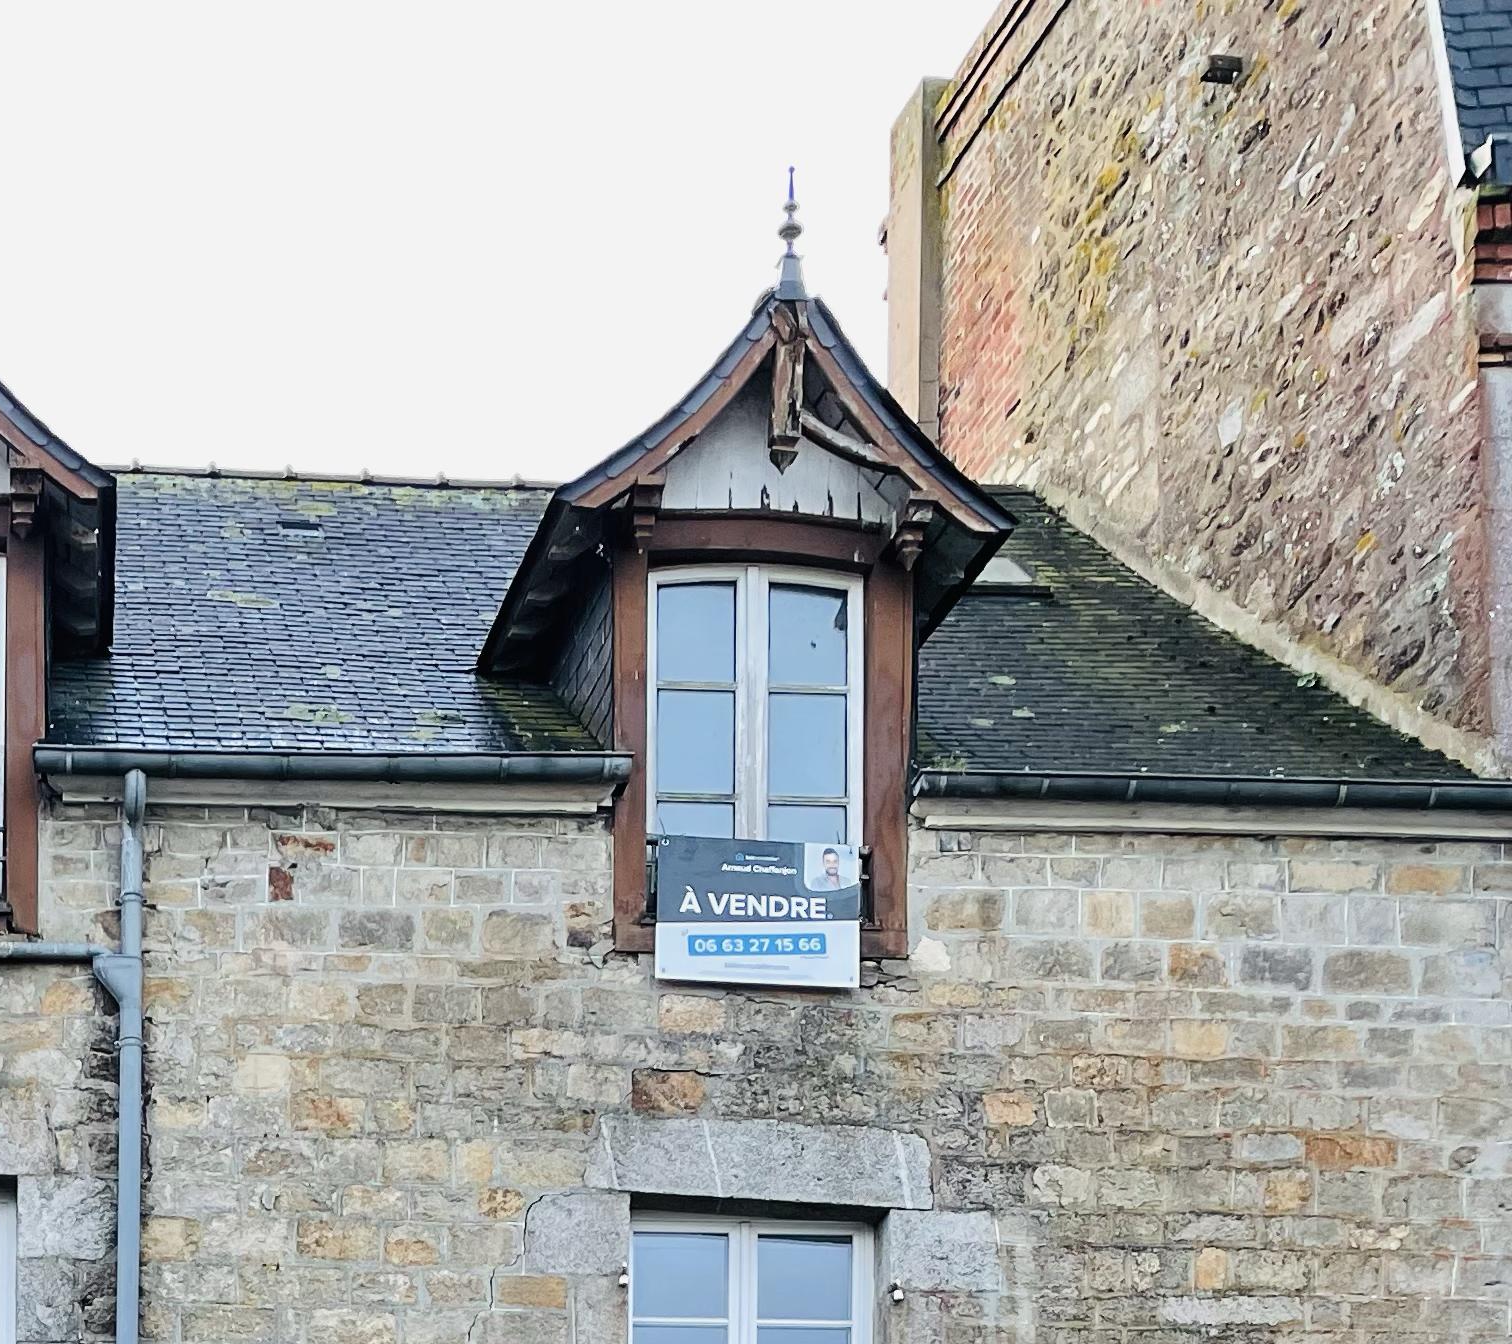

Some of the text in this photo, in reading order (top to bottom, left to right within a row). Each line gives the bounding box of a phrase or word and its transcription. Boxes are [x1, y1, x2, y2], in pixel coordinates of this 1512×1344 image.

[679, 885, 702, 914] À
[694, 937, 822, 953] 06 63 27 15 66
